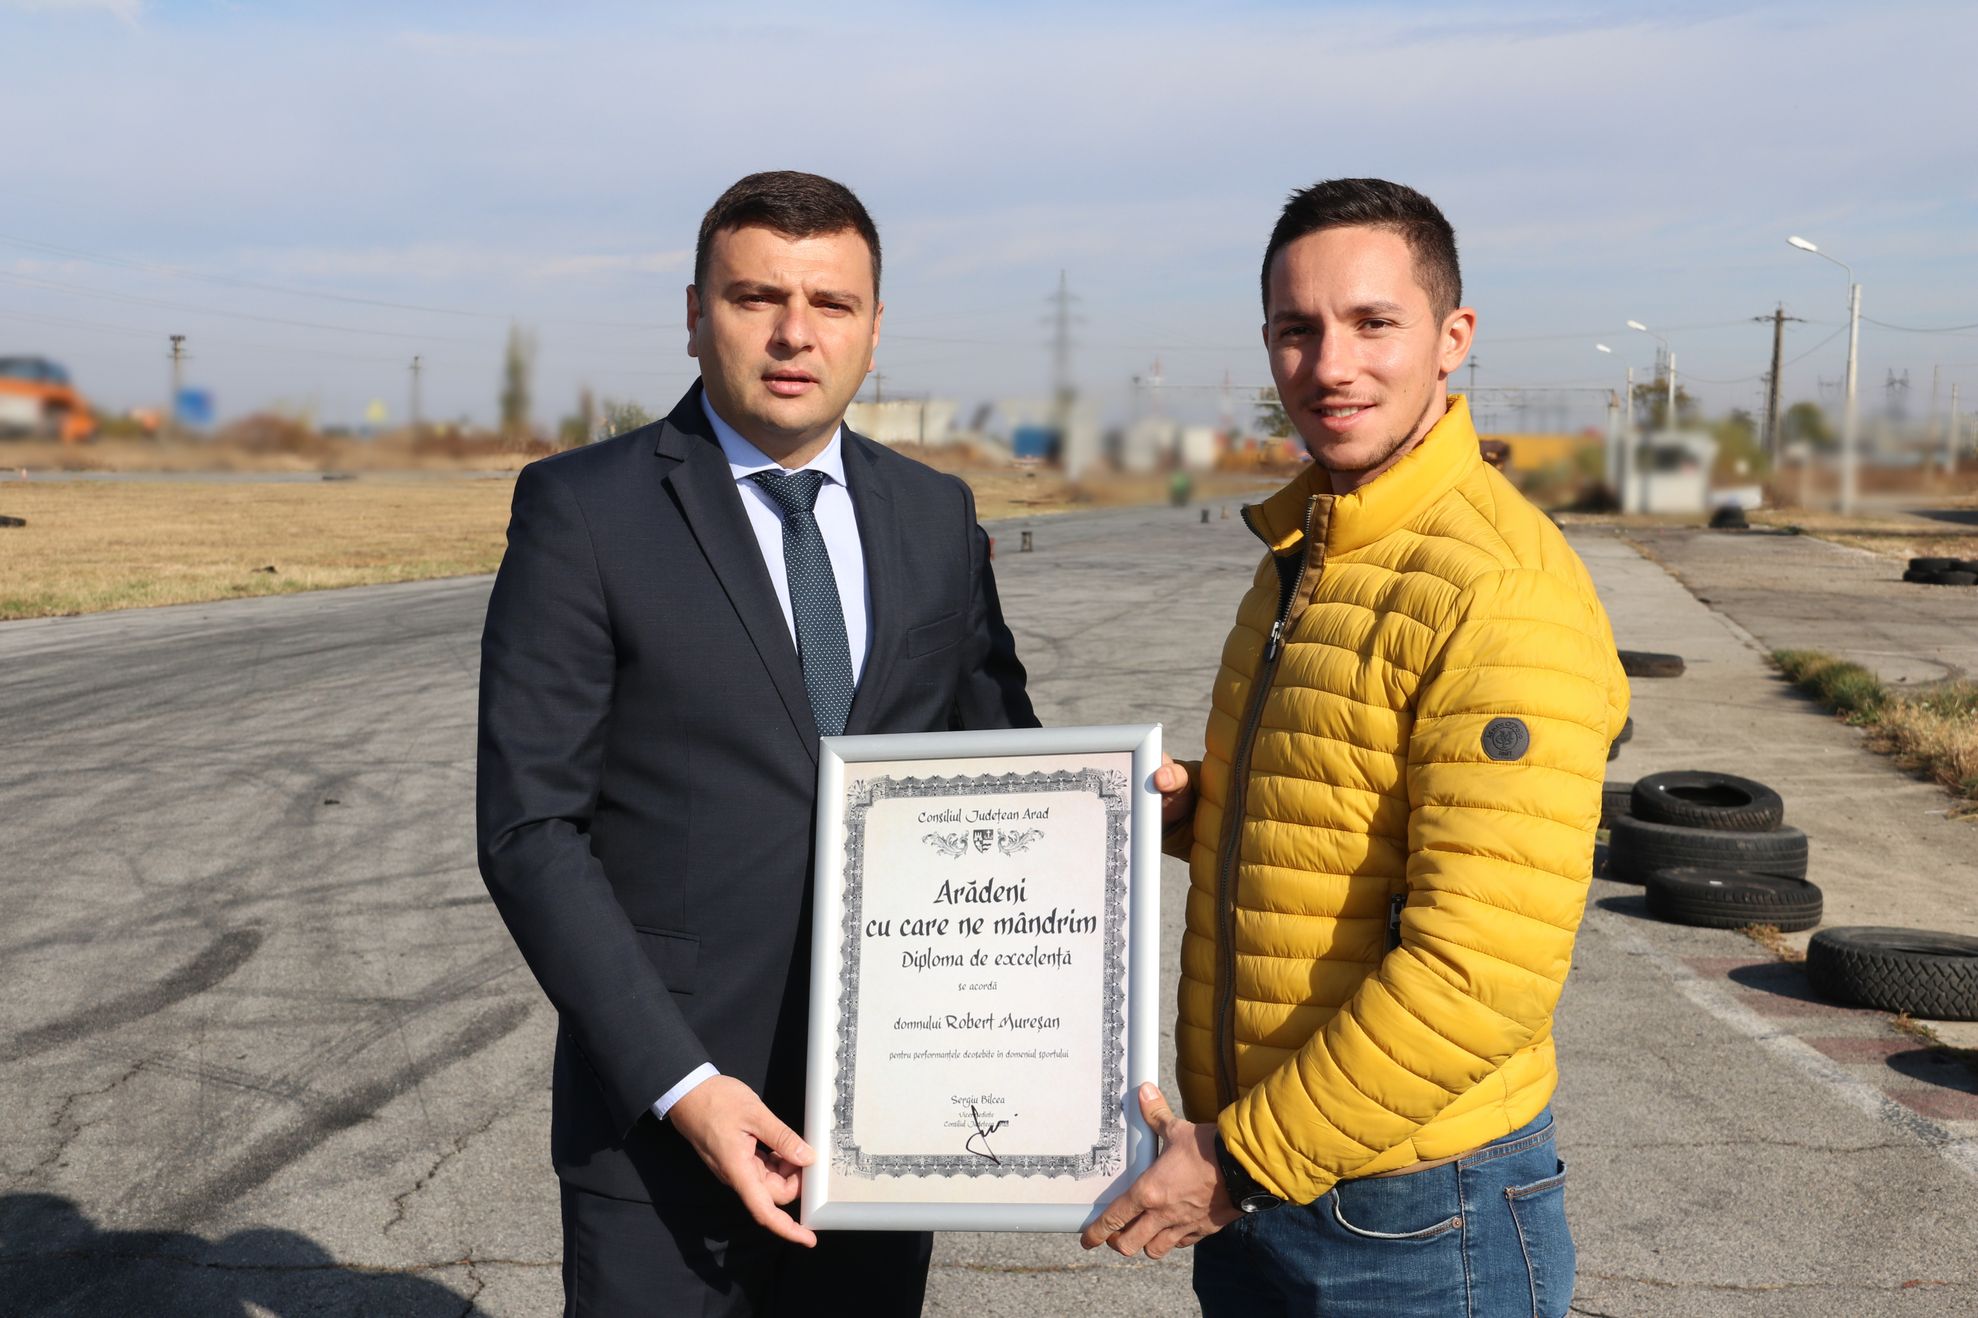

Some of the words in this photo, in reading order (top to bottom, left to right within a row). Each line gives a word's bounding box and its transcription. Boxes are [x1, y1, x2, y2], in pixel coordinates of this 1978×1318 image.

[918, 808, 962, 823] Consiliul
[965, 808, 1019, 824] Județean
[1022, 807, 1050, 820] Arad
[933, 877, 1028, 905] Arădeni
[866, 920, 891, 937] cu
[900, 918, 949, 937] care
[958, 917, 984, 938] ne
[993, 907, 1097, 937] mândrim
[902, 947, 964, 973] Diploma
[970, 948, 988, 966] de
[995, 945, 1072, 970] excelență
[969, 981, 997, 990] acordă
[894, 1015, 941, 1031] domnului
[944, 1012, 995, 1030] Robert
[998, 1013, 1060, 1033] Mureșan
[889, 1050, 911, 1061] pentru
[1005, 1049, 1036, 1058] domeniul
[1039, 1048, 1069, 1060] sportului
[951, 1095, 978, 1107] Sergiu
